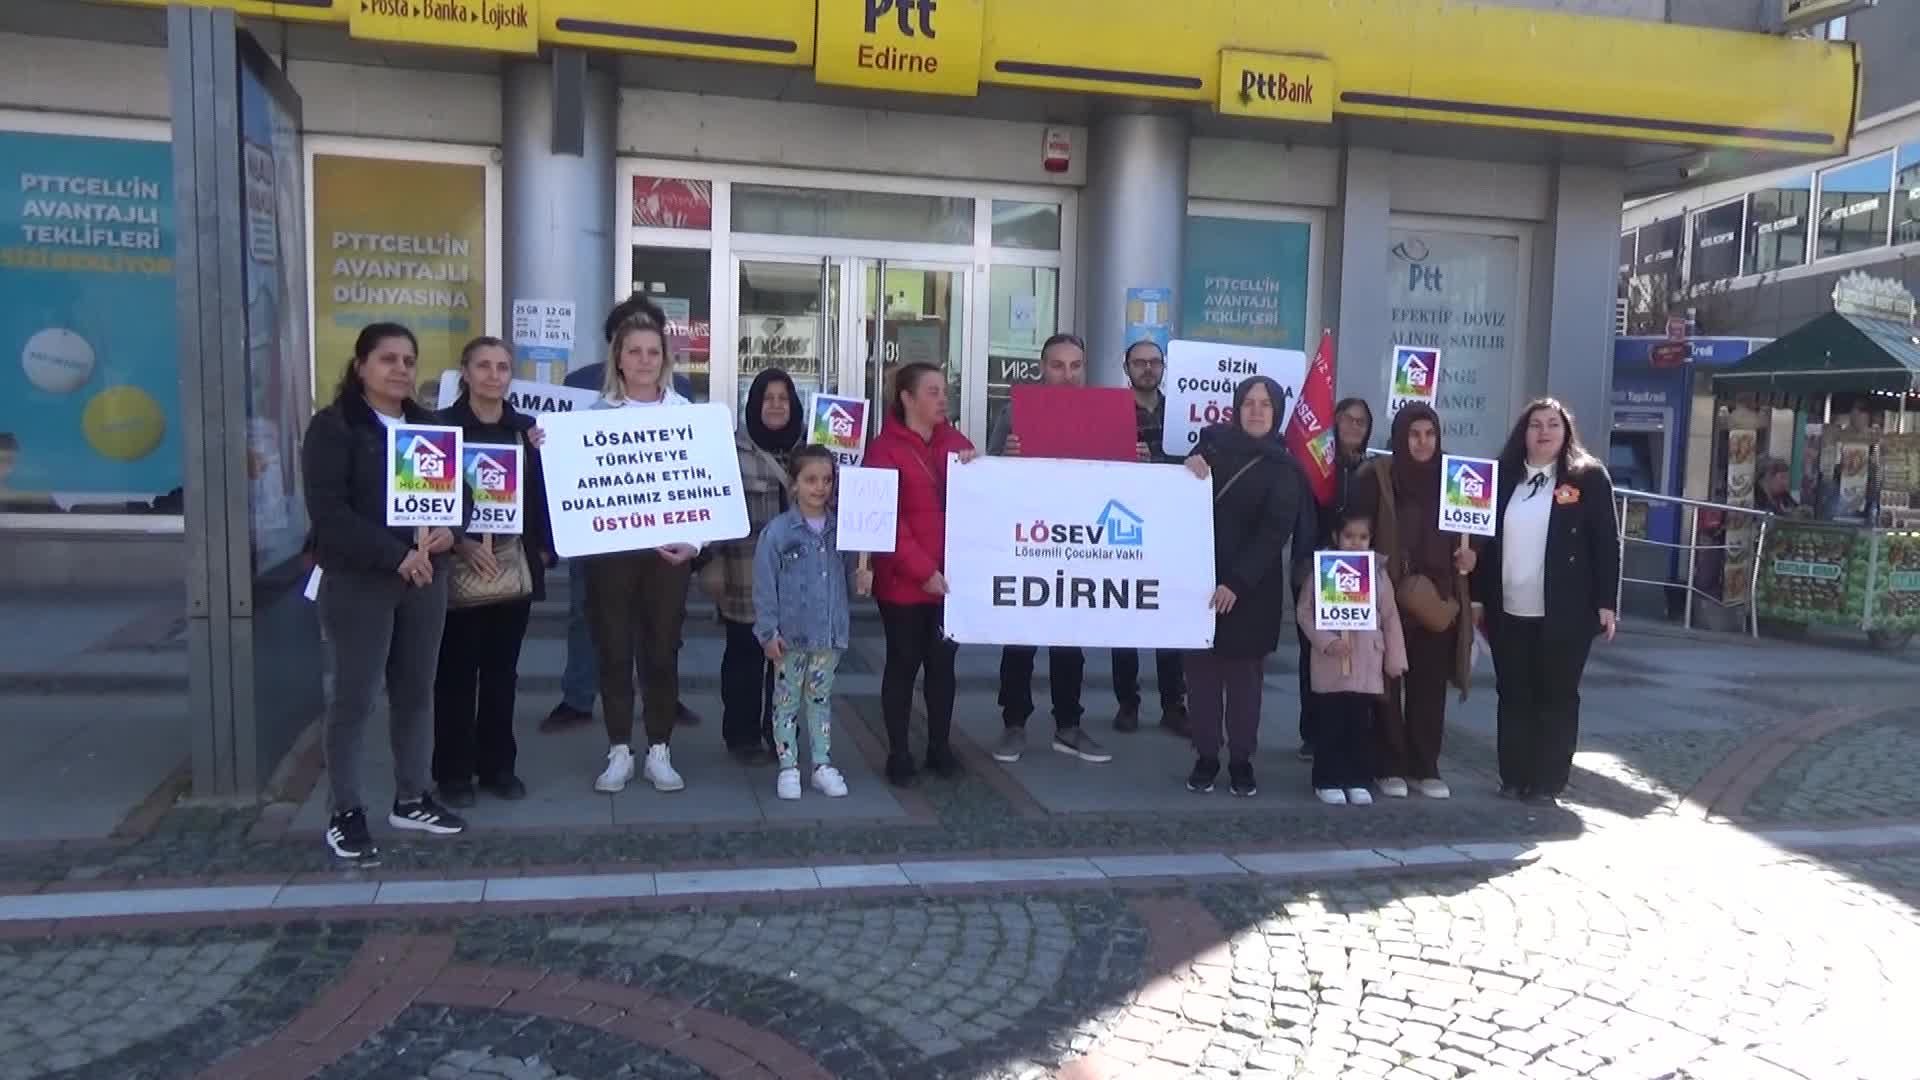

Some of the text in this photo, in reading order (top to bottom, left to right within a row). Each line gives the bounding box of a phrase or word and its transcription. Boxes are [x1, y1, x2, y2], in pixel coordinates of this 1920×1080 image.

[371, 0, 528, 30] Posta Banka Lojistik
[864, 0, 937, 39] Ptt
[858, 44, 938, 73] Edirne
[1242, 69, 1313, 105] PttBank
[22, 199, 159, 225] AVANTAJLI
[22, 223, 160, 249] TEKLİFLERİ
[334, 257, 469, 282] AVANTAJLI
[1408, 263, 1443, 292] Ptt
[333, 280, 469, 308] DÜNYASINA
[1204, 295, 1279, 309] AVANTAJLI
[1204, 309, 1279, 326] TEKLİFLERİ
[1218, 358, 1258, 374] SİZİN
[509, 391, 574, 413] AMAN
[582, 424, 694, 447] LÖSANTE'Yİ
[596, 449, 689, 467] TÜRKİYE'YE
[577, 466, 712, 489] ARMAĞAN ETTİN,
[394, 495, 456, 513] LÖSEV
[562, 485, 732, 511] DUALARIMIZ SENİNLE
[471, 505, 516, 522] ÖSEV
[592, 508, 711, 533] ÜSTÜN EZER
[1444, 509, 1491, 526] LÖSEV
[1015, 520, 1104, 544] LÖSEV
[1015, 546, 1062, 558] Lösemili
[1064, 546, 1113, 560] Çocuklar
[992, 569, 1159, 610] EDİRNE
[1320, 607, 1371, 620] LÖSEV
